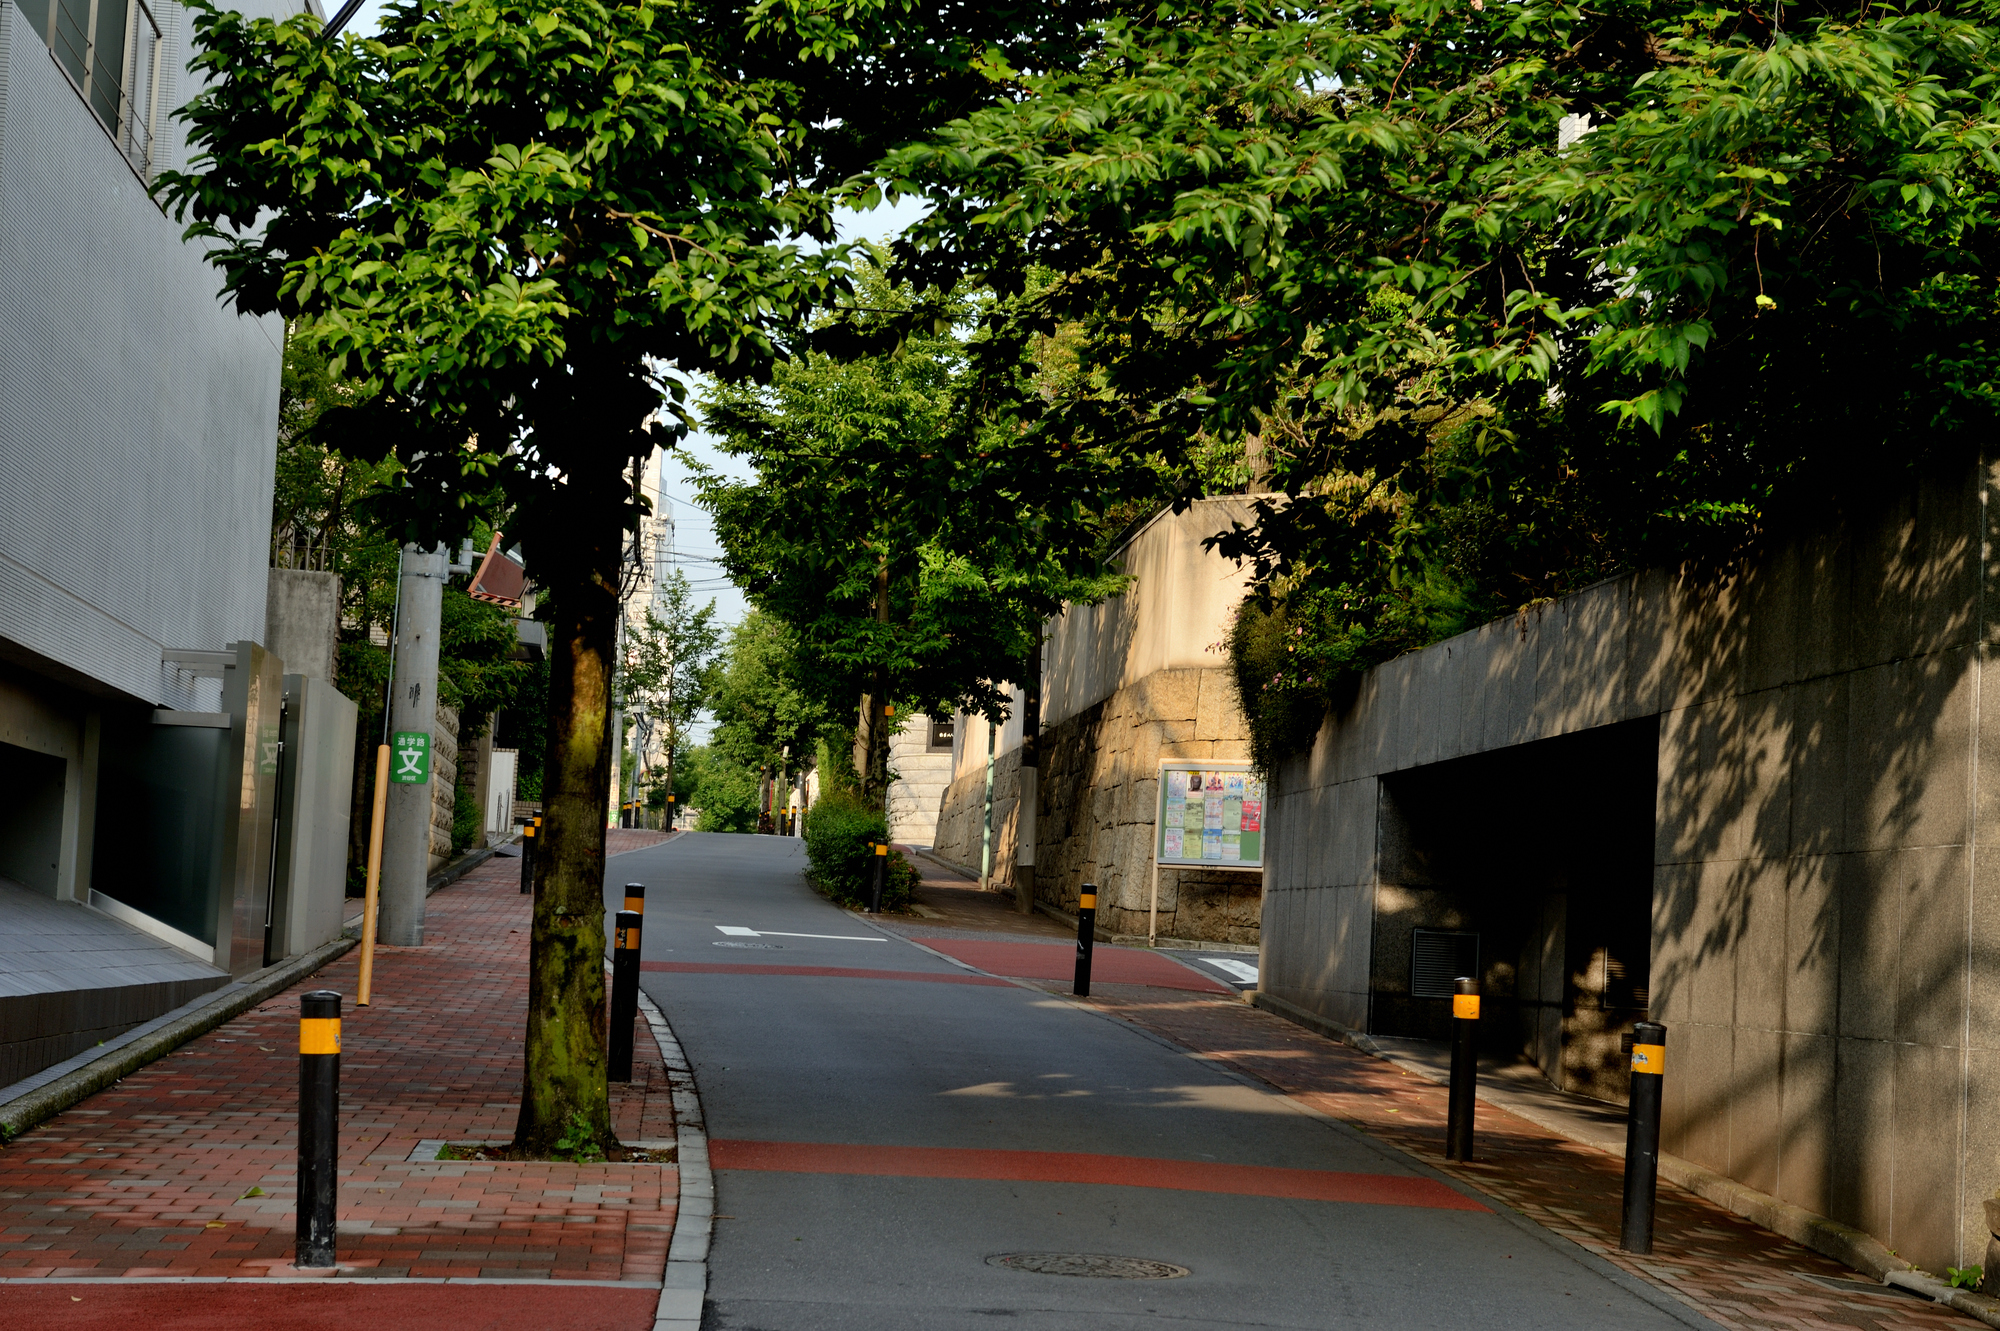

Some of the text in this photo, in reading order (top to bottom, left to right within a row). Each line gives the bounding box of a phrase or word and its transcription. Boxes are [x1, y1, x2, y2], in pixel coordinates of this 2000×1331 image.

[398, 737, 424, 746] 通学路
[398, 747, 422, 774] 文
